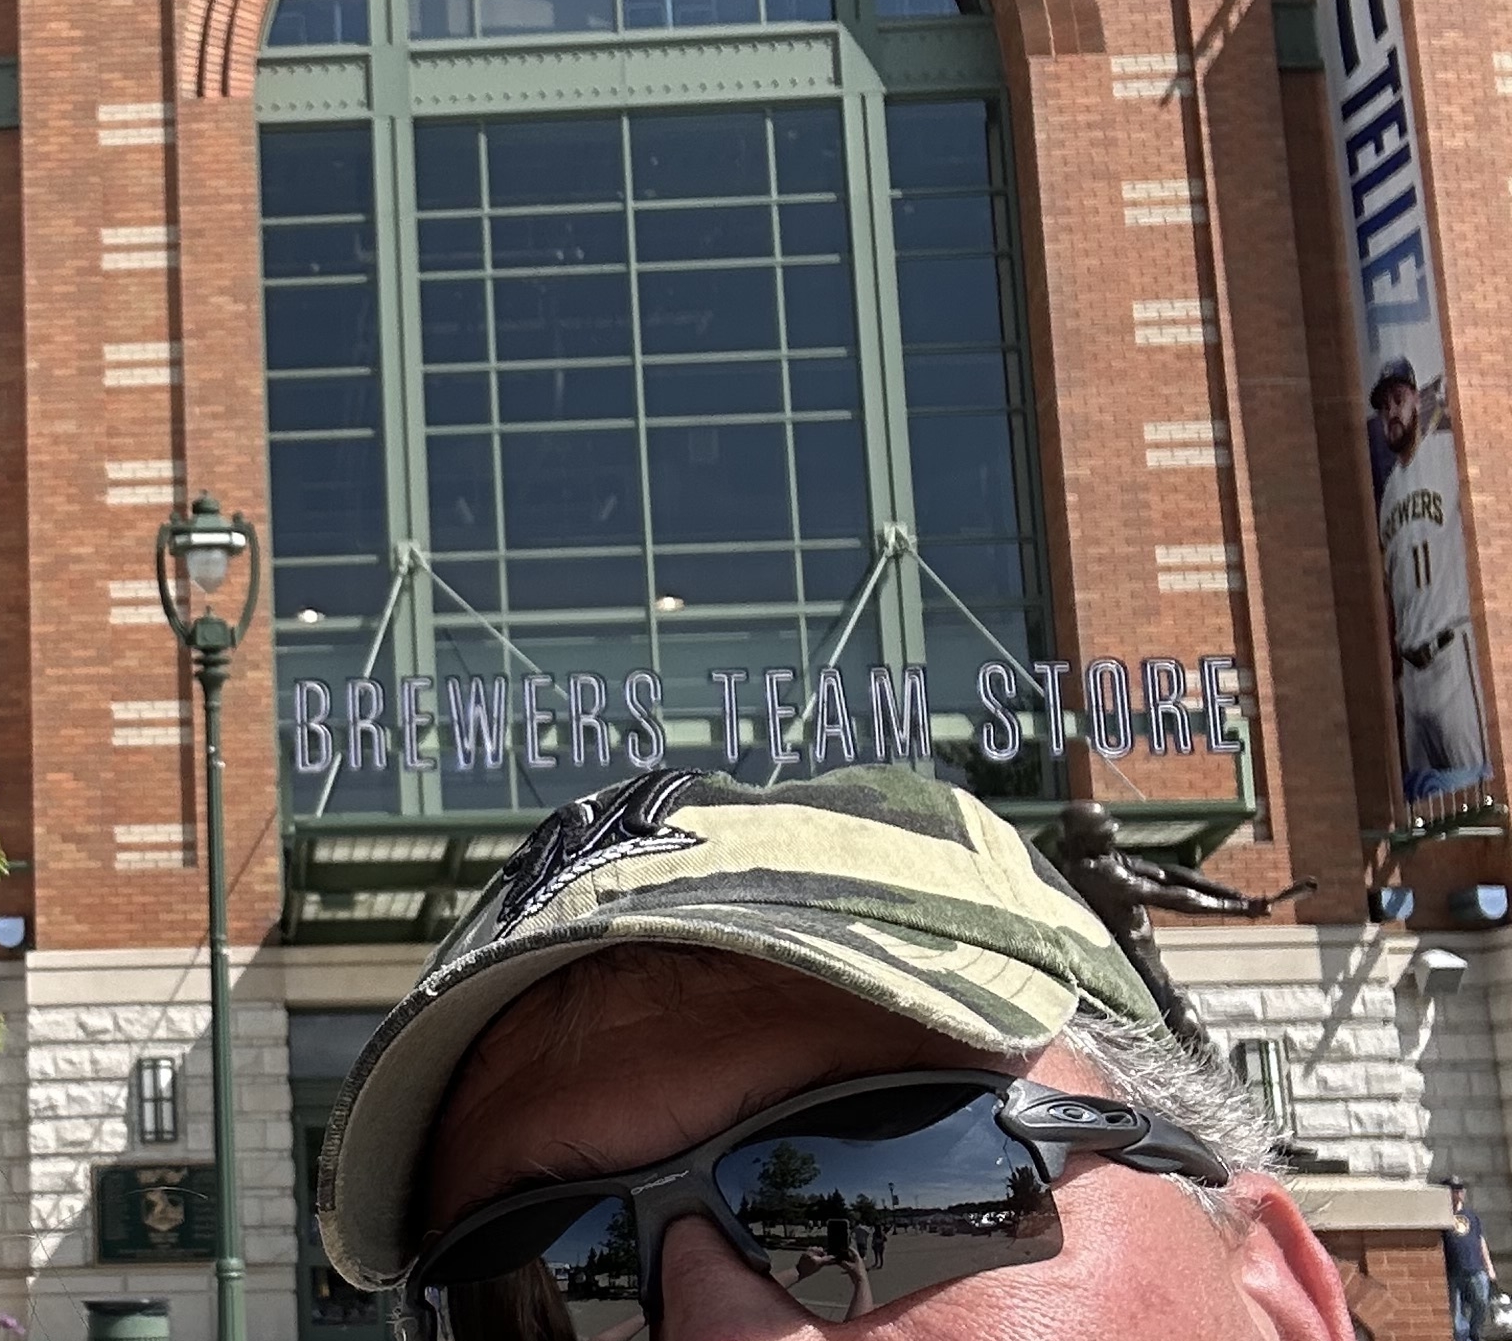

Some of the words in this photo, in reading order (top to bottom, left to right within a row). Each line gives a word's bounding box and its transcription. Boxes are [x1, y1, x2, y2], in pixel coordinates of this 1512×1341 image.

[1340, 46, 1432, 355] TELLEZ
[293, 670, 666, 772] BREWERS
[711, 665, 932, 764] TEAM
[979, 657, 1243, 763] STORE
